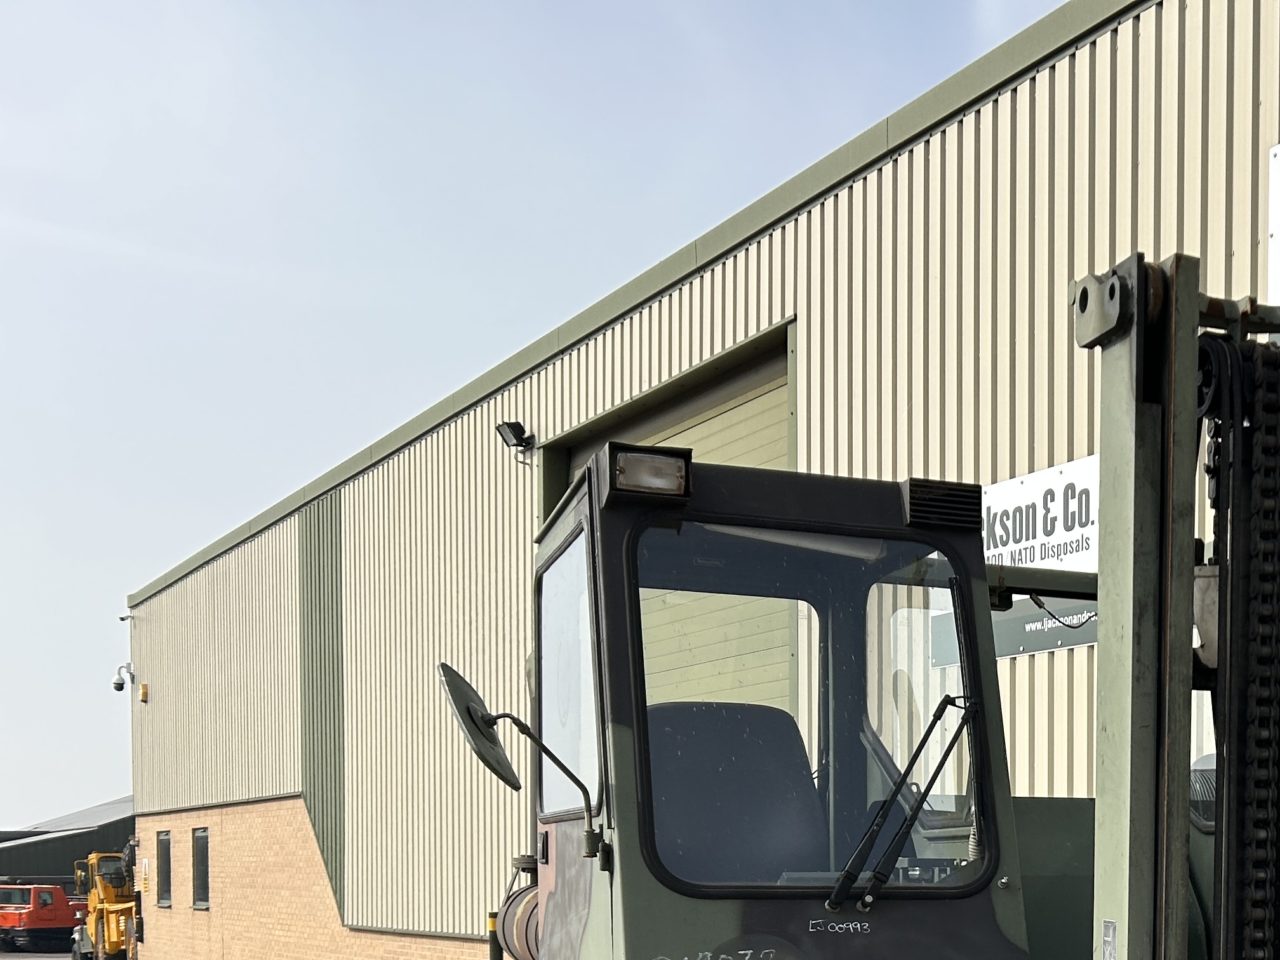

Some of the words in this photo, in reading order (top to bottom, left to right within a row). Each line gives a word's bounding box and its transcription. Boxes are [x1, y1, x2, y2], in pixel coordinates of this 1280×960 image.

[982, 502, 1037, 551] kson
[1042, 488, 1058, 537] &
[1063, 482, 1095, 532] Co.
[1040, 533, 1090, 561] Disposals
